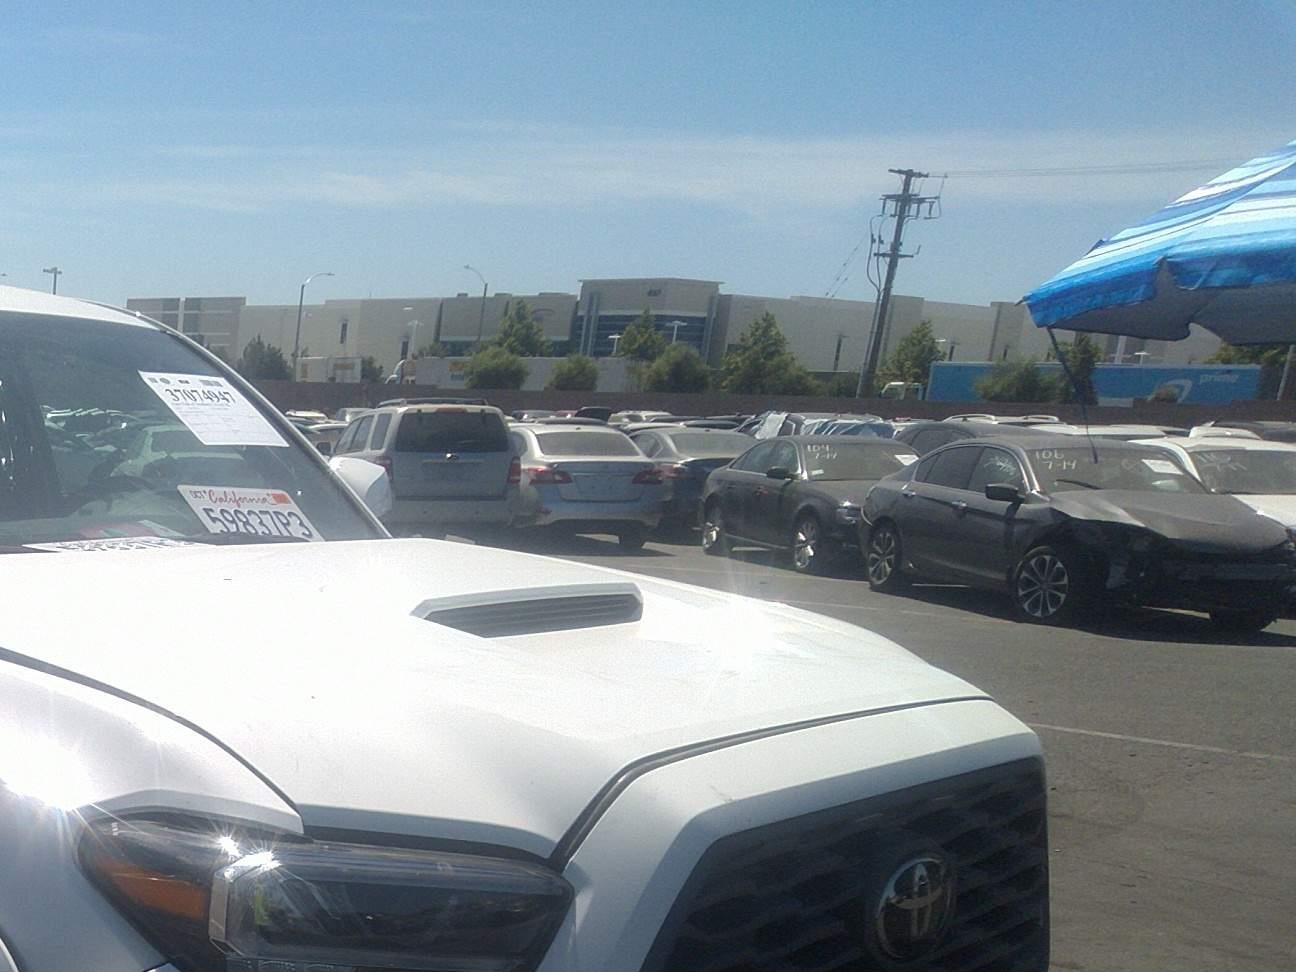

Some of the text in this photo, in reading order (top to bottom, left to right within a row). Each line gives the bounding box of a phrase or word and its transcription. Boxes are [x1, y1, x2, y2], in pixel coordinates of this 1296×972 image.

[165, 388, 237, 404] 37074947
[208, 490, 271, 508] California
[202, 507, 313, 539] 59837P3
